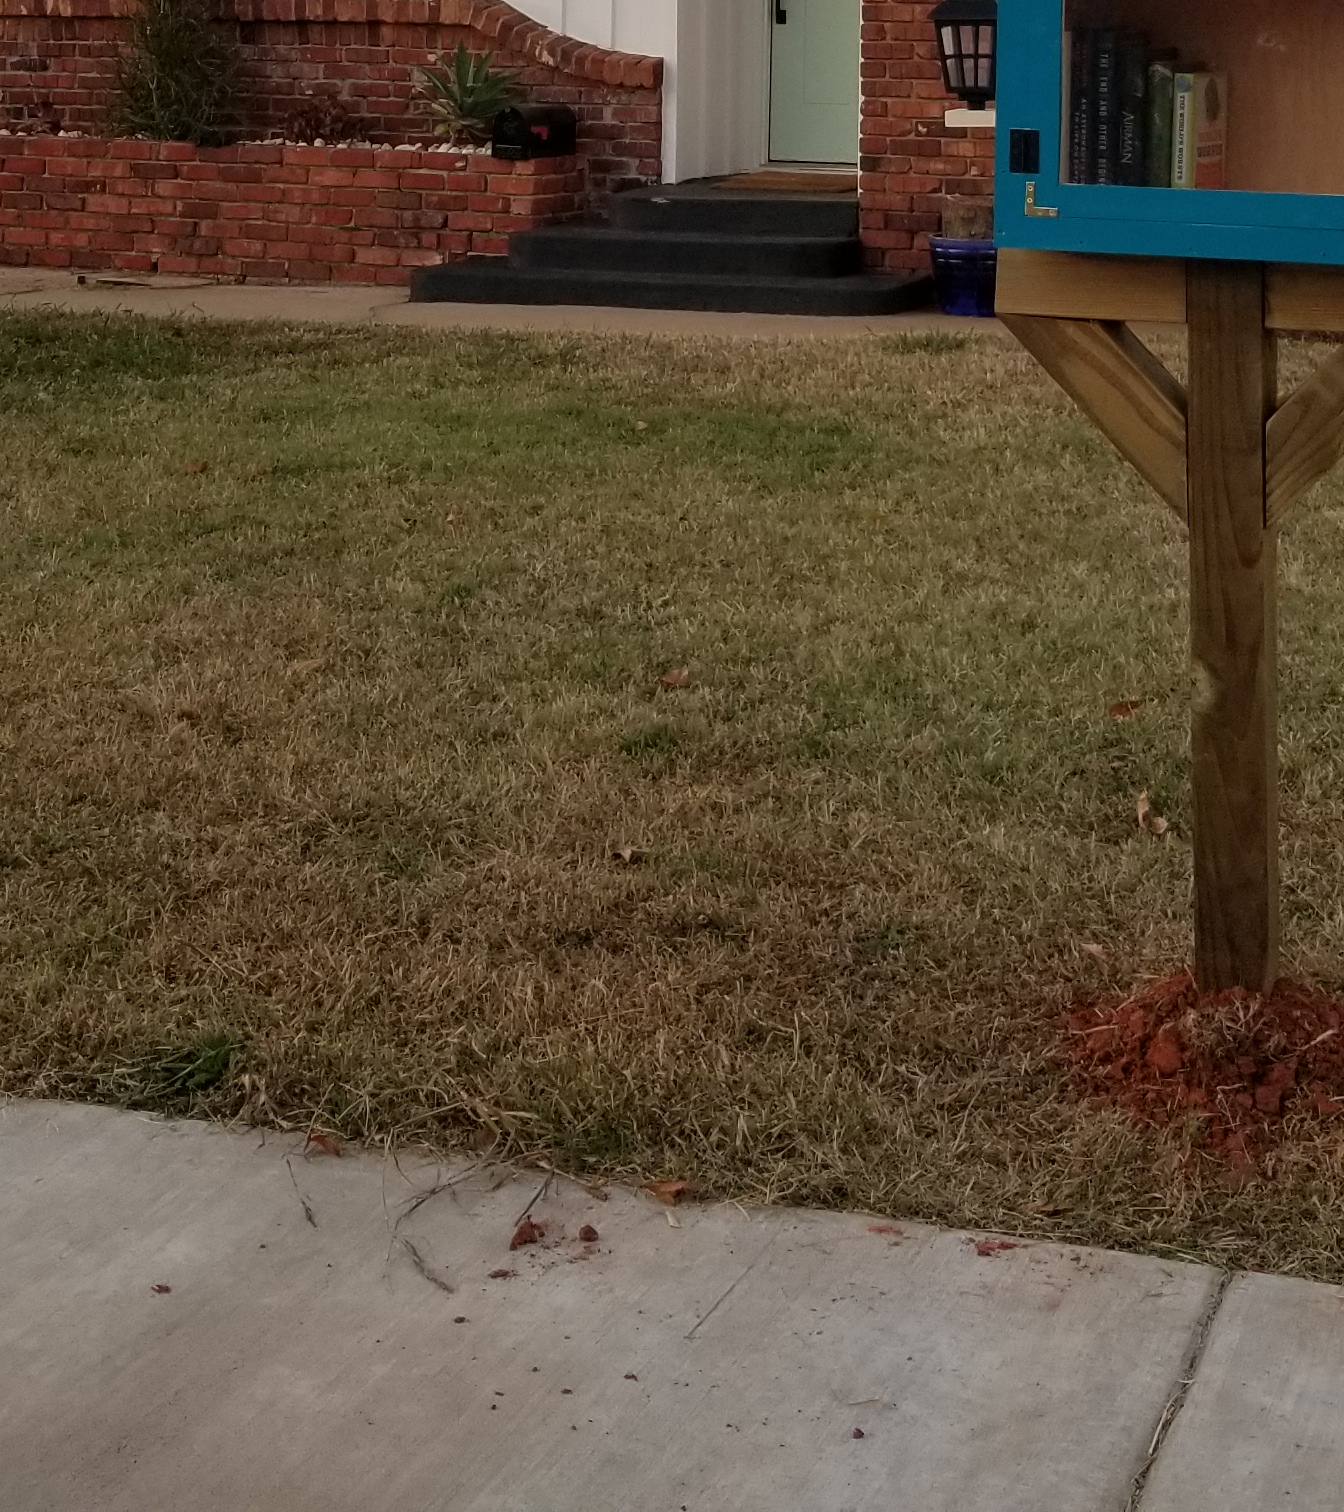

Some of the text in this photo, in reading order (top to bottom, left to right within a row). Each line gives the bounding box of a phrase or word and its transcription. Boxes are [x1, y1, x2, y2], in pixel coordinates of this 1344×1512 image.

[1099, 53, 1109, 68] THE
[1099, 76, 1109, 93] END
[1098, 100, 1108, 117] AND
[1098, 125, 1108, 150] OTHER
[1120, 111, 1135, 164] AIRMAN
